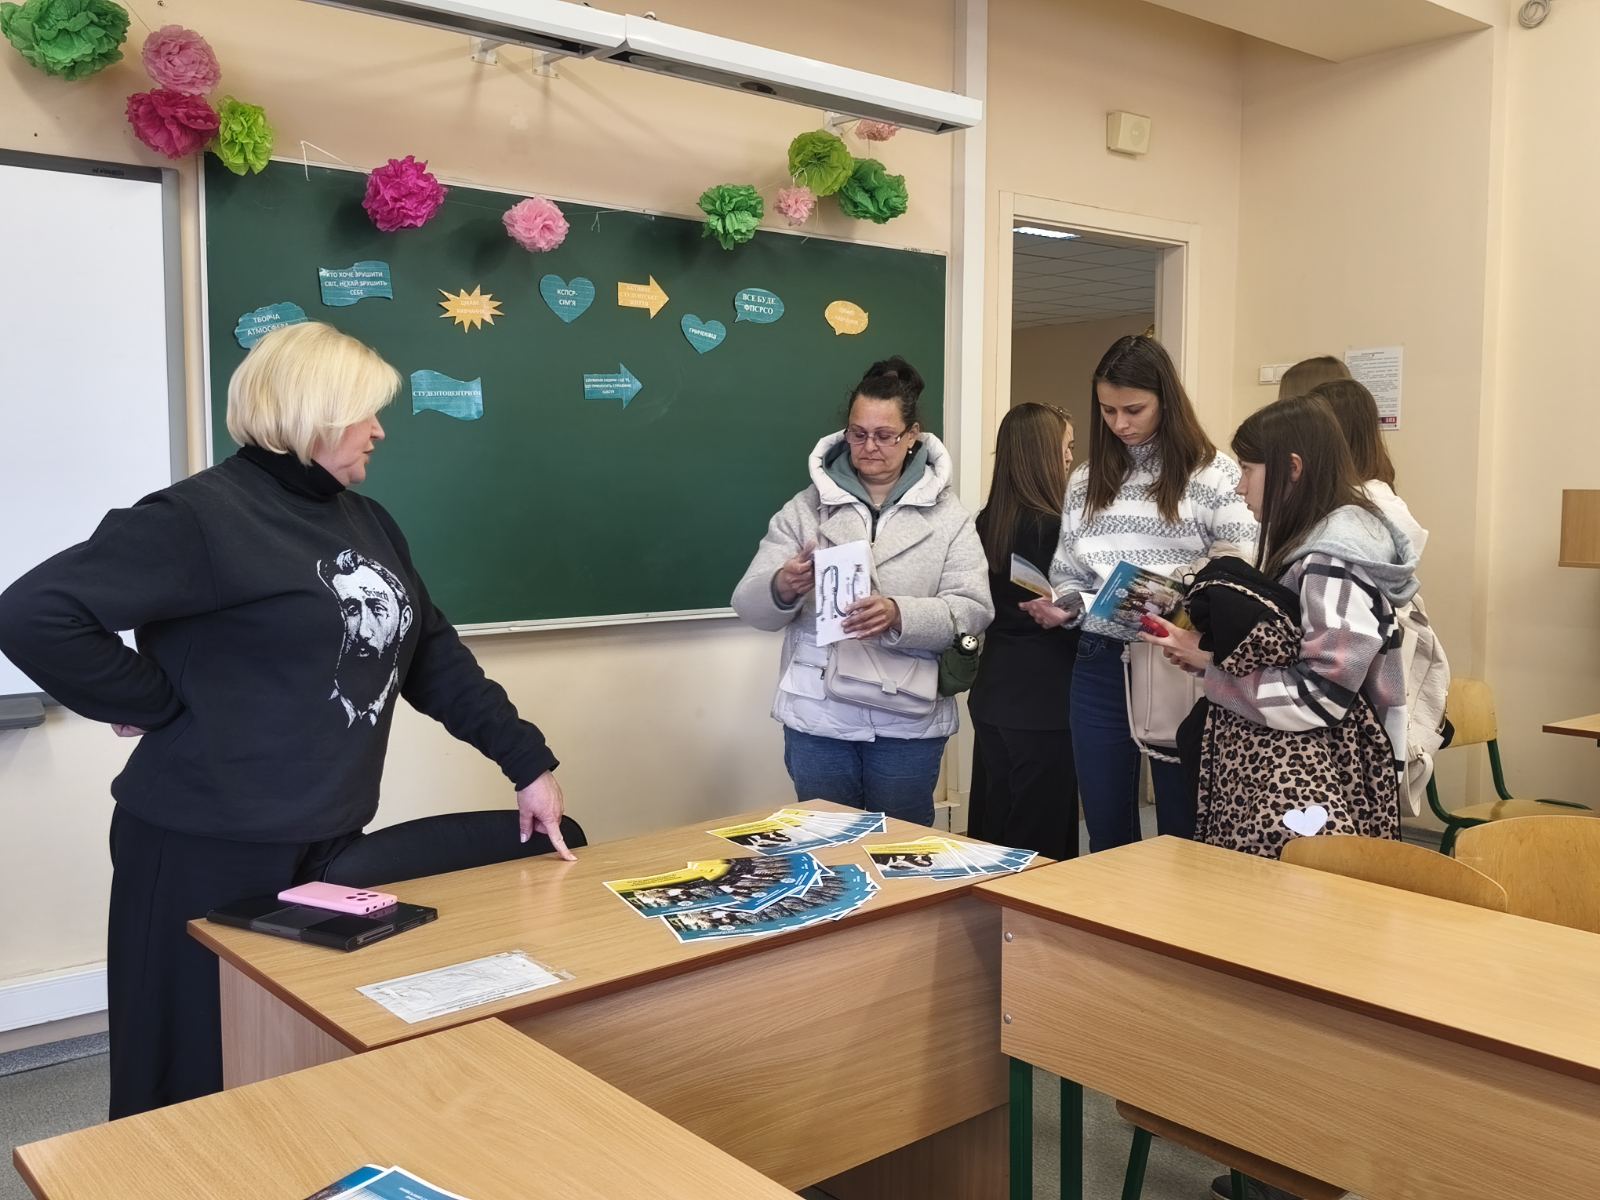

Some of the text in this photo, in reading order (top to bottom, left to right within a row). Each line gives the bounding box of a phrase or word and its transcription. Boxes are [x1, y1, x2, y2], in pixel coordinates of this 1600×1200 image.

[742, 293, 776, 304] ВСЕ БУДЕ
[743, 304, 774, 315] ФПСРСО
[253, 313, 281, 324] ТВОРЧА
